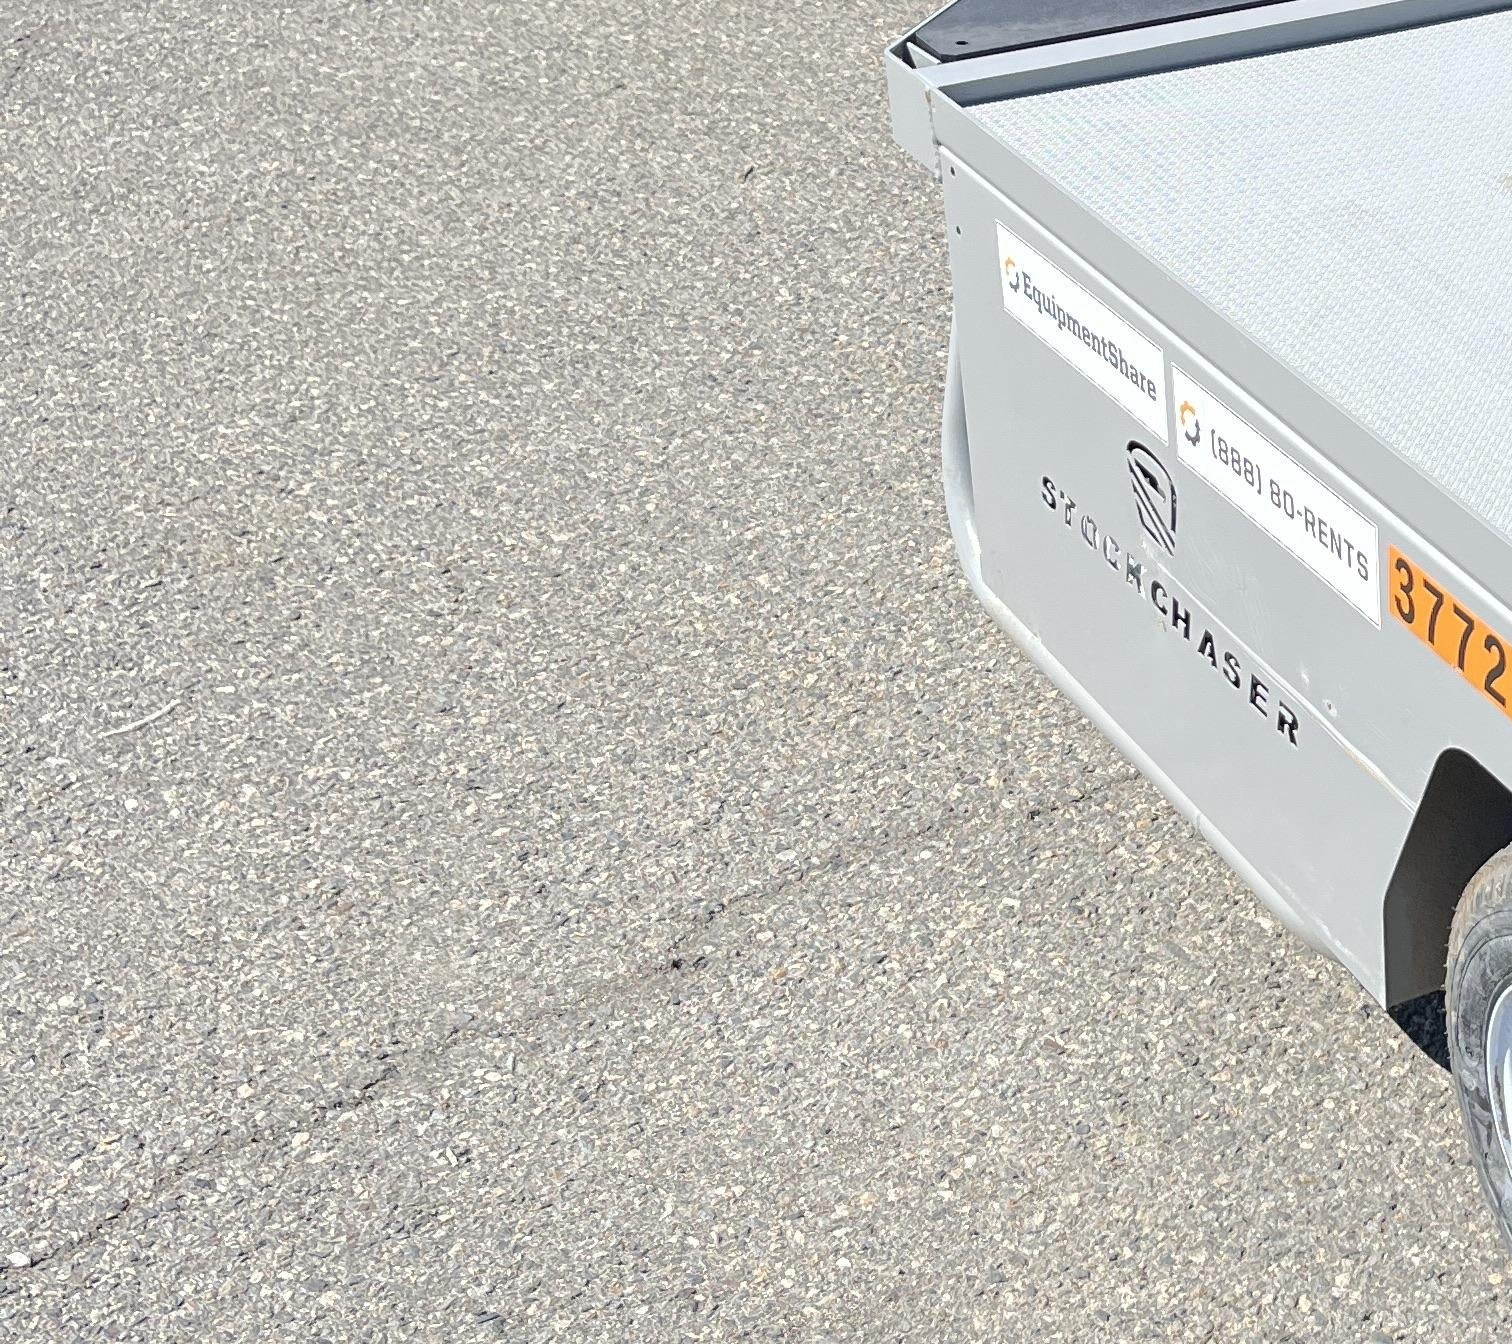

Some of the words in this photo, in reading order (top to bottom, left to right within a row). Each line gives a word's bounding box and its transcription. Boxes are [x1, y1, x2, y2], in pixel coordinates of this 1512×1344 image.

[1022, 271, 1158, 403] EquipmentShare
[1210, 427, 1263, 496] (888)
[1269, 474, 1370, 583] 80-RENTS
[1040, 475, 1299, 747] STOCKCHASER
